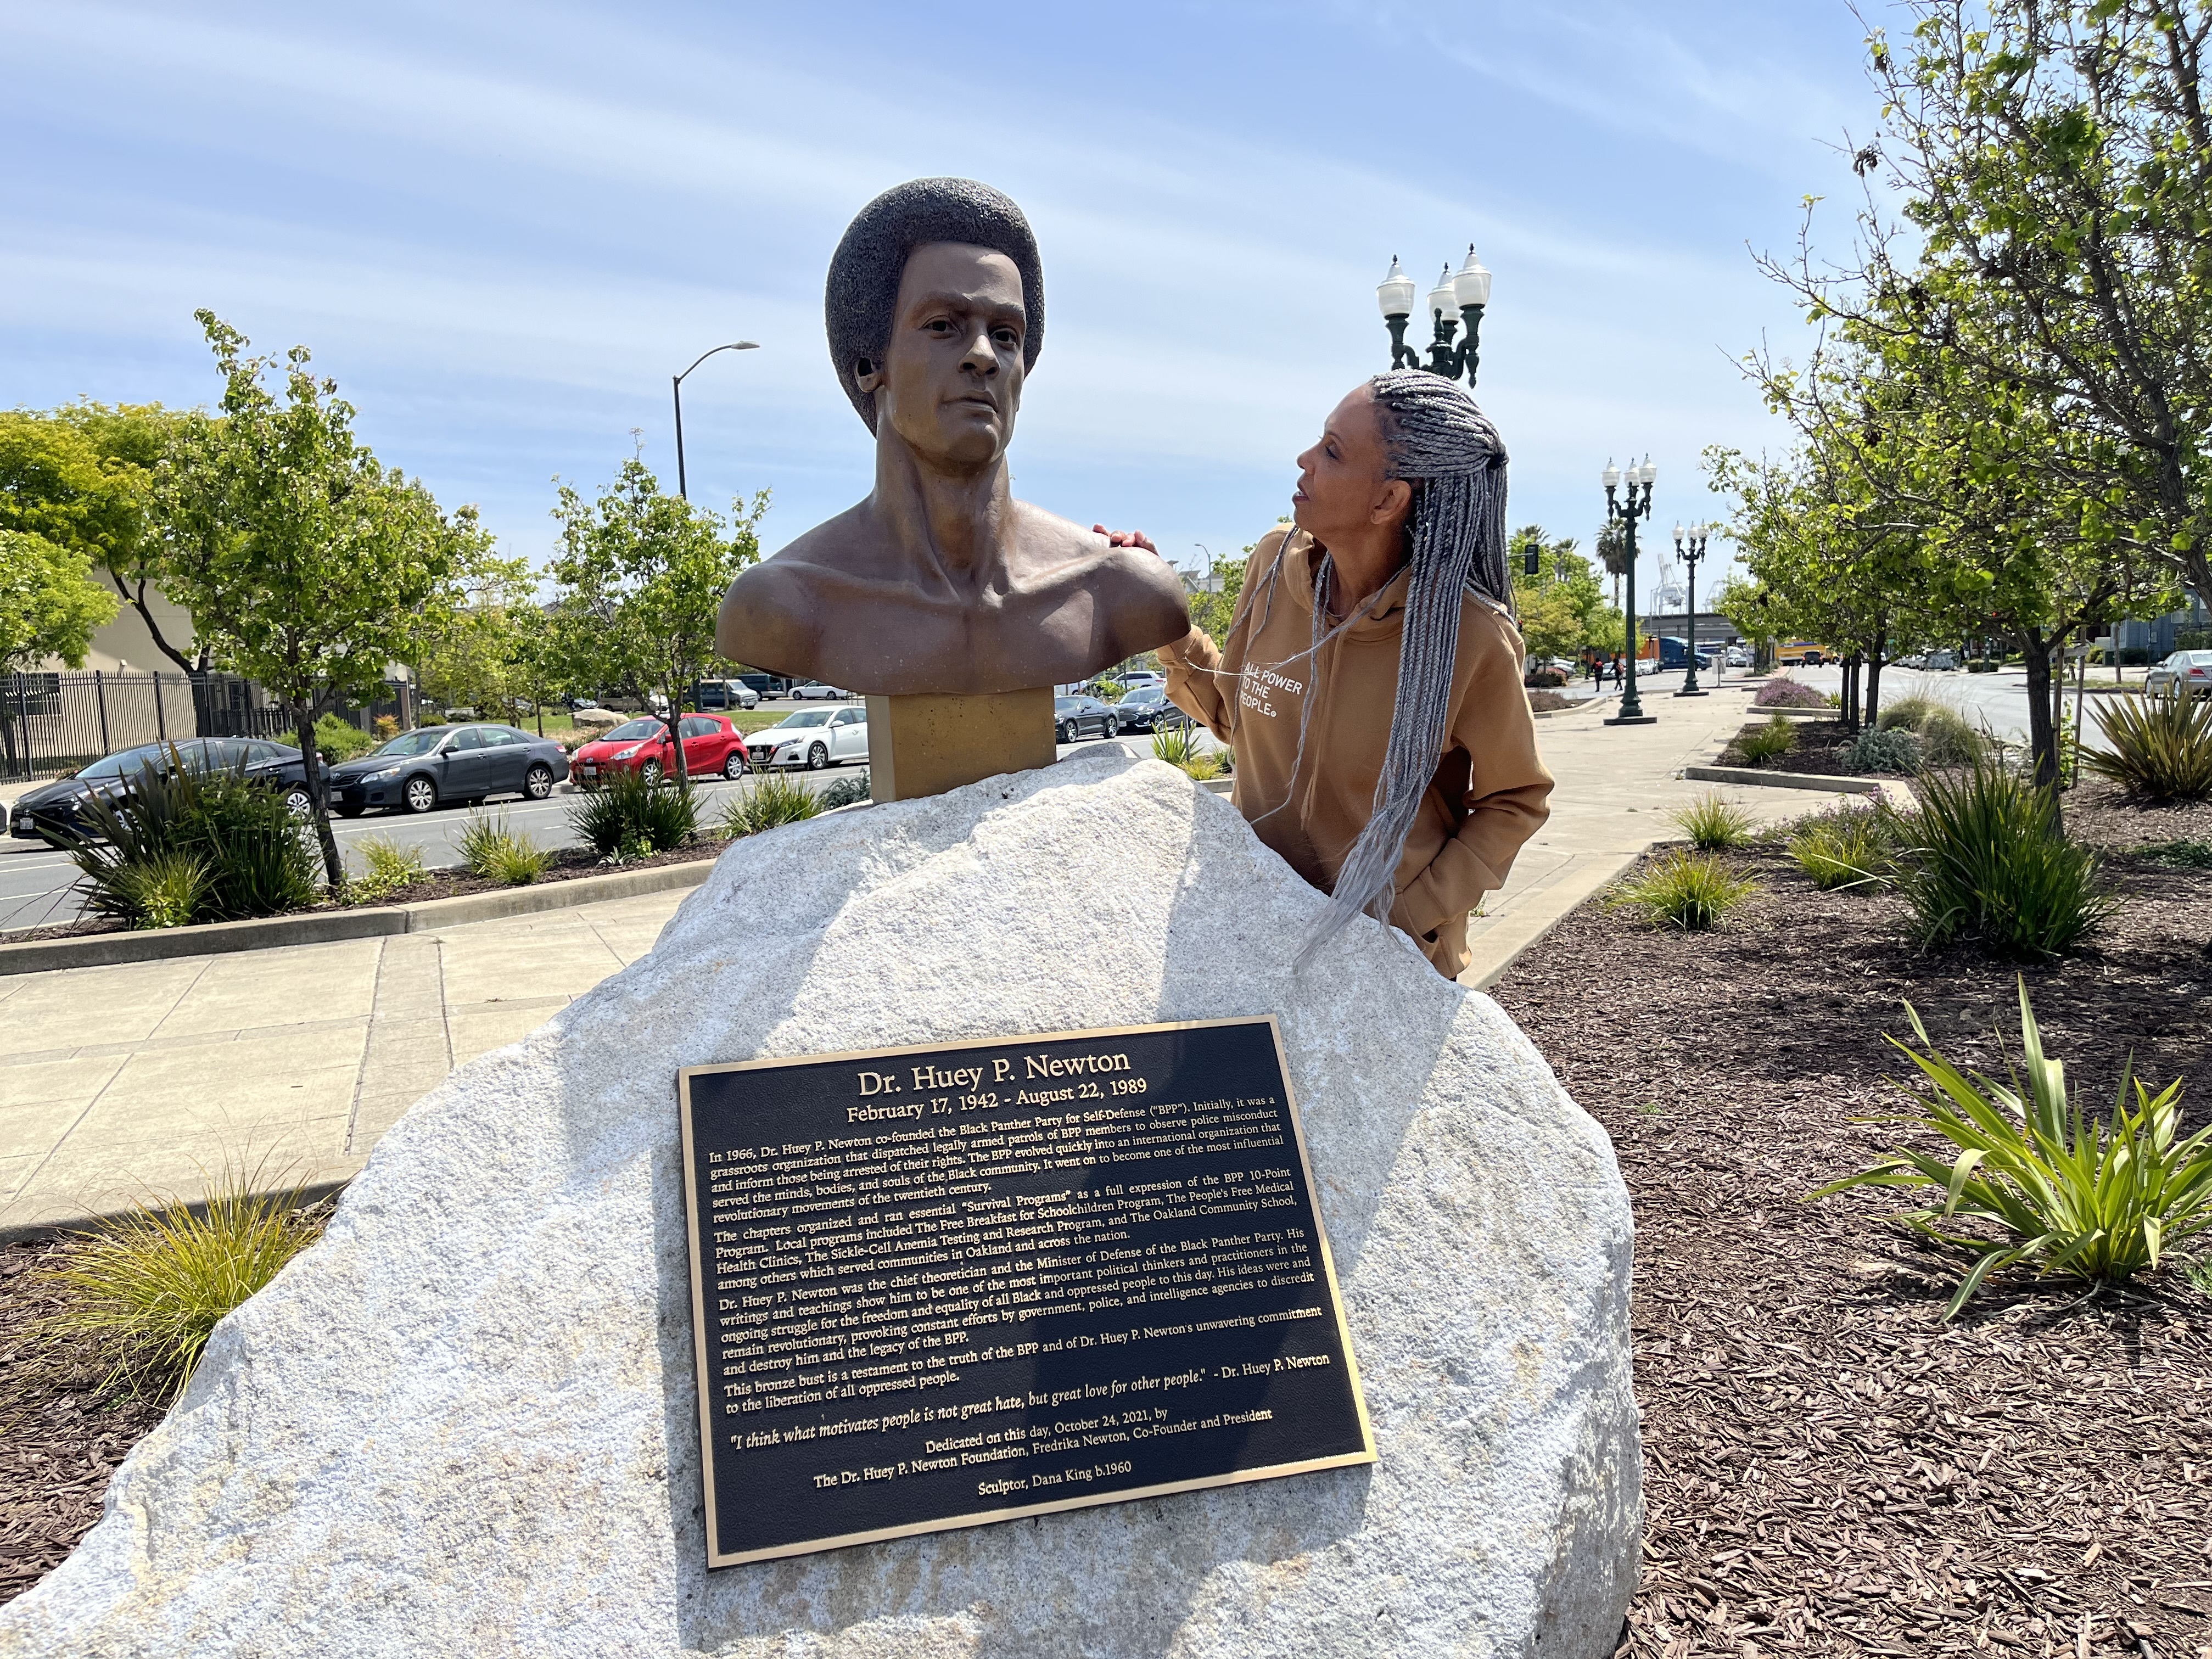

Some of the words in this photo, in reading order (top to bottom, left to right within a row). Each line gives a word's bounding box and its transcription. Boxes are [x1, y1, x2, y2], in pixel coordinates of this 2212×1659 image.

[1242, 675, 1251, 690] TO
[1251, 680, 1271, 699] THE
[1244, 662, 1259, 679] ALL
[1261, 670, 1303, 695] POWER
[856, 1071, 901, 1096] Dr.
[910, 1064, 983, 1091] Huey
[991, 1058, 1015, 1082] P.
[1023, 1052, 1131, 1079] Newton
[845, 1103, 925, 1123] February
[929, 1096, 952, 1114] 17,
[957, 1092, 999, 1111] 1942
[1015, 1086, 1075, 1107] August
[1077, 1081, 1105, 1099] 22,
[1109, 1077, 1147, 1096] 1989
[708, 1151, 723, 1163] In
[725, 1147, 757, 1161] 1966,
[759, 1146, 779, 1157] Dr.
[781, 1143, 812, 1155] Huey
[814, 1140, 825, 1151] P.
[827, 1136, 873, 1150] Newton
[875, 1127, 937, 1145] co-founded
[937, 1125, 957, 1137] the
[958, 1122, 989, 1135] Black
[990, 1118, 1032, 1132] Panther
[1033, 1116, 1063, 1128] Party
[1065, 1113, 1080, 1124] for
[1082, 1107, 1146, 1122] Self-Defense
[1192, 1098, 1234, 1111] Initially,
[1235, 1097, 1245, 1107] it
[1246, 1097, 1266, 1106] was
[713, 1206, 789, 1223] revolutionary
[791, 1197, 856, 1214] movements
[857, 1192, 871, 1206] of
[871, 1192, 891, 1204] the
[893, 1185, 947, 1202] twentieth
[948, 1182, 992, 1195] century.
[715, 1244, 769, 1259] Program.
[775, 1236, 807, 1251] Local
[809, 1231, 863, 1250] programs
[865, 1223, 914, 1240] included
[914, 1221, 938, 1234] The
[939, 1219, 964, 1231] Free
[966, 1212, 1017, 1228] Breakfast
[1018, 1209, 1035, 1221] for
[1037, 1201, 1115, 1219] Schoolchildren
[1116, 1197, 1164, 1210] Program,
[1165, 1192, 1187, 1204] The
[1230, 1186, 1253, 1197] Free
[1254, 1180, 1294, 1194] Medical
[715, 1258, 757, 1274] Health
[758, 1254, 803, 1269] Clinics,
[804, 1249, 829, 1263] The
[830, 1240, 892, 1260] Sickle-Cell
[893, 1237, 939, 1252] Anemia
[938, 1232, 981, 1246] Testing
[982, 1227, 1004, 1241] and
[1004, 1221, 1055, 1238] Research
[1055, 1218, 1105, 1232] Program,
[1107, 1213, 1128, 1225] and
[1129, 1211, 1151, 1223] The
[1152, 1205, 1197, 1220] Oakland
[1199, 1200, 1258, 1215] Community
[1260, 1194, 1297, 1208] School,
[719, 1311, 769, 1326] writings
[771, 1305, 795, 1320] and
[797, 1300, 852, 1316] teachings
[855, 1295, 887, 1309] show
[888, 1291, 912, 1304] him
[915, 1290, 928, 1301] to
[930, 1286, 945, 1298] be
[948, 1285, 969, 1296] one
[972, 1280, 985, 1293] of
[986, 1279, 1006, 1291] the
[1008, 1275, 1037, 1288] most
[1039, 1269, 1093, 1286] important
[1096, 1261, 1139, 1280] political
[1141, 1258, 1185, 1271] thinkers
[1188, 1253, 1208, 1265] and
[1210, 1248, 1274, 1266] practitioners
[1276, 1245, 1288, 1255] in
[1290, 1242, 1308, 1253] the
[721, 1342, 765, 1360] remain
[767, 1333, 847, 1353] revolutionary,
[850, 1324, 908, 1345] provoking
[910, 1317, 959, 1333] constant
[961, 1313, 998, 1326] efforts
[1000, 1309, 1015, 1323] by
[1017, 1302, 1085, 1322] government,
[1088, 1296, 1123, 1313] police,
[1126, 1291, 1146, 1304] and
[1149, 1286, 1208, 1302] intelligence
[1211, 1279, 1254, 1296] agencies
[1256, 1279, 1268, 1288] to
[1270, 1271, 1315, 1286] discredit
[725, 1403, 739, 1414] to
[741, 1397, 762, 1412] the
[764, 1390, 822, 1409] liberation
[825, 1385, 839, 1399] of
[840, 1383, 856, 1398] all
[858, 1375, 917, 1397] oppressed
[919, 1370, 960, 1390] people.
[745, 1428, 781, 1448] think
[782, 1425, 816, 1442] what
[818, 1417, 878, 1437] motivates
[881, 1408, 920, 1432] people
[923, 1406, 934, 1422] is
[936, 1404, 958, 1420] not
[960, 1399, 992, 1420] great
[994, 1395, 1024, 1411] hate,
[1027, 1391, 1048, 1406] but
[1051, 1387, 1082, 1406] great
[1084, 1383, 1108, 1398] love
[1110, 1379, 1128, 1399] for
[1130, 1375, 1161, 1391] other
[1220, 1366, 1239, 1378] Dr.
[1241, 1363, 1271, 1376] Huey
[1273, 1358, 1284, 1371] P.
[1284, 1354, 1330, 1370] Newton
[813, 1473, 838, 1488] The
[840, 1471, 860, 1484] Dr.
[863, 1466, 895, 1481] Huey
[897, 1461, 908, 1475] P.
[910, 1456, 958, 1473] Newton
[960, 1447, 1029, 1465] Foundation,
[1032, 1437, 1080, 1454] Fredrika
[1082, 1432, 1130, 1447] Newton,
[1132, 1419, 1197, 1439] Co-Founder
[1200, 1414, 1220, 1428] and
[1222, 1408, 1273, 1425] President
[925, 1432, 984, 1454] Dedicated
[985, 1432, 1001, 1444] on
[1003, 1427, 1026, 1442] this
[1029, 1425, 1051, 1439] day,
[1054, 1418, 1099, 1433] October
[1101, 1414, 1119, 1427] 24,
[1121, 1409, 1152, 1424] 2021,
[1153, 1406, 1168, 1421] by
[977, 1478, 1029, 1495] Sculptor,
[1031, 1473, 1063, 1487] Dana
[1064, 1468, 1093, 1482] King
[1094, 1460, 1132, 1477] b.1960
